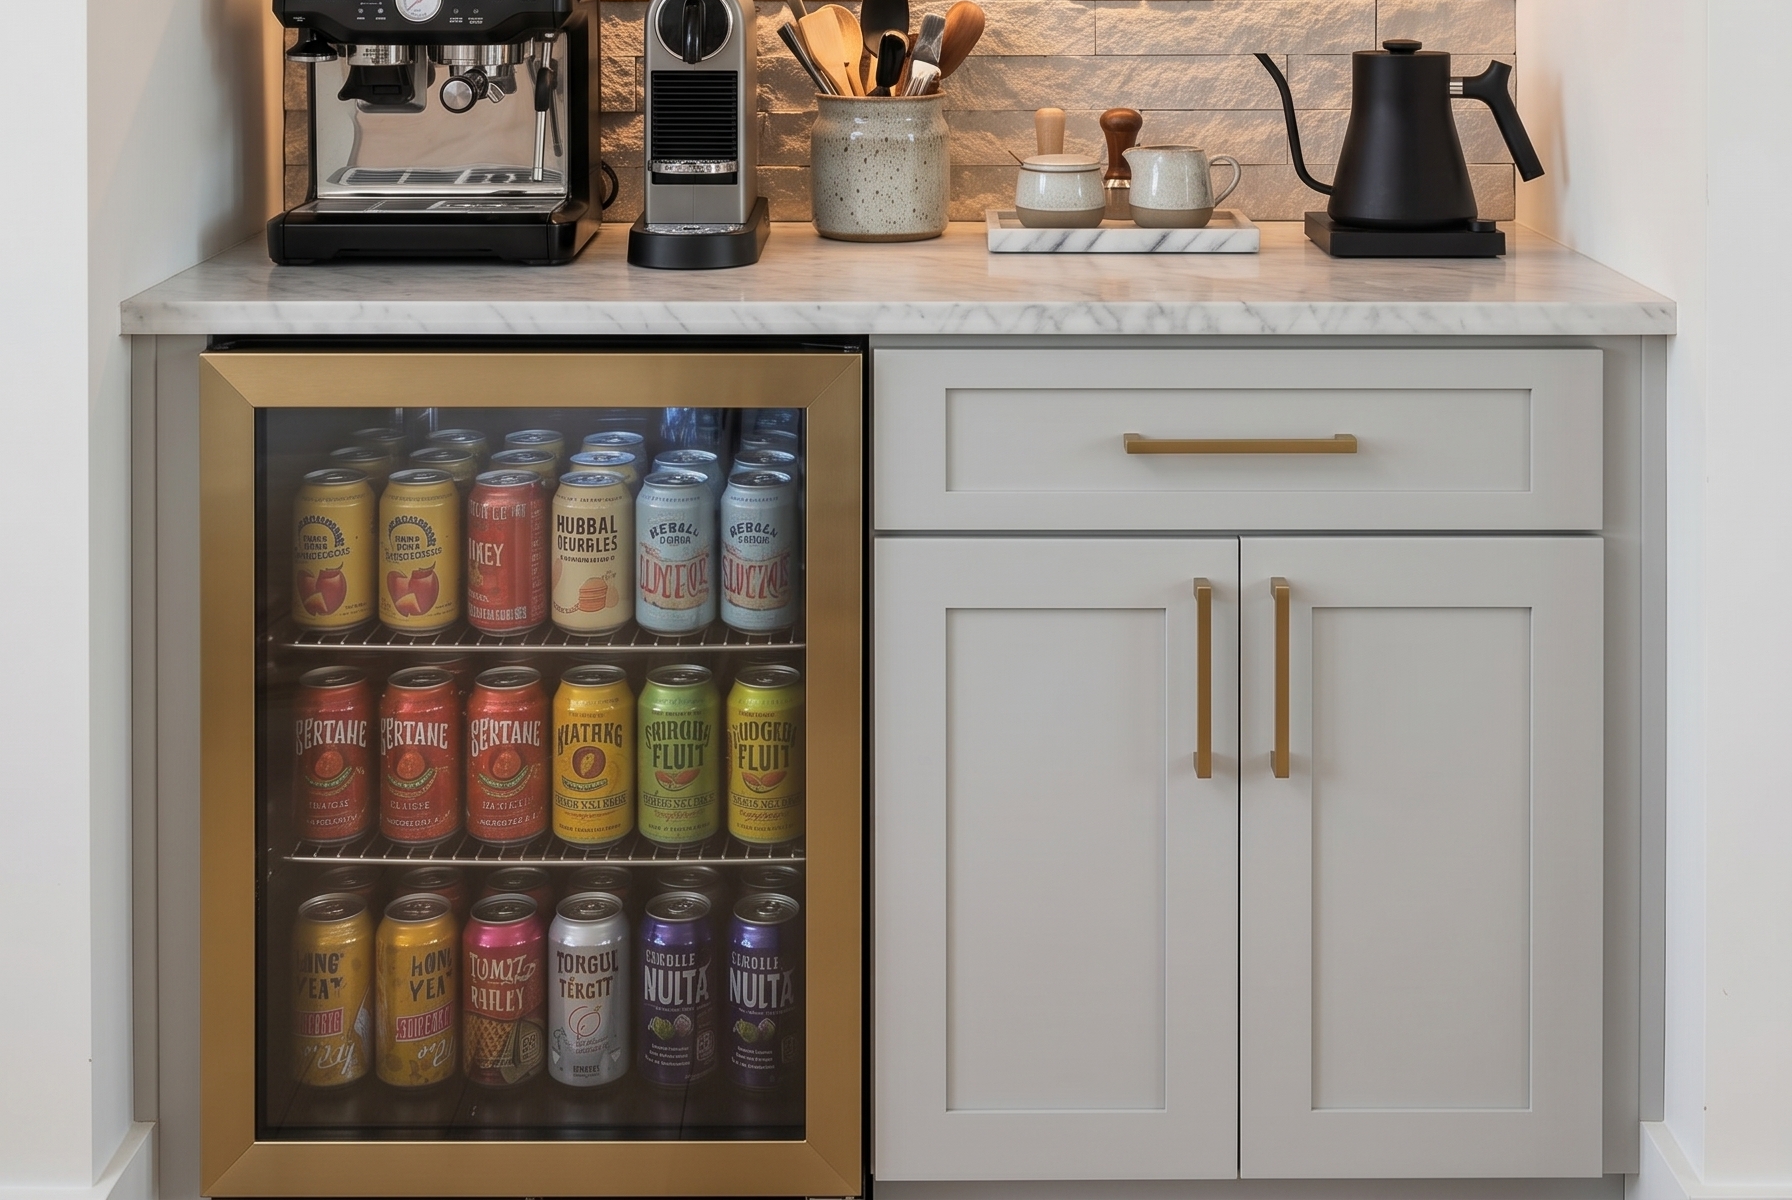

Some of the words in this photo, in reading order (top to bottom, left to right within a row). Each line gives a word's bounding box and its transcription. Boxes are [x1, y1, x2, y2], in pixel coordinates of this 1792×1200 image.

[556, 514, 618, 535] HUBBAL
[653, 743, 705, 770] FLUIT
[738, 743, 791, 772] FLUIT
[556, 949, 619, 975] TORGUL
[644, 960, 710, 1006] NULTA
[729, 967, 795, 1009] NULTA
